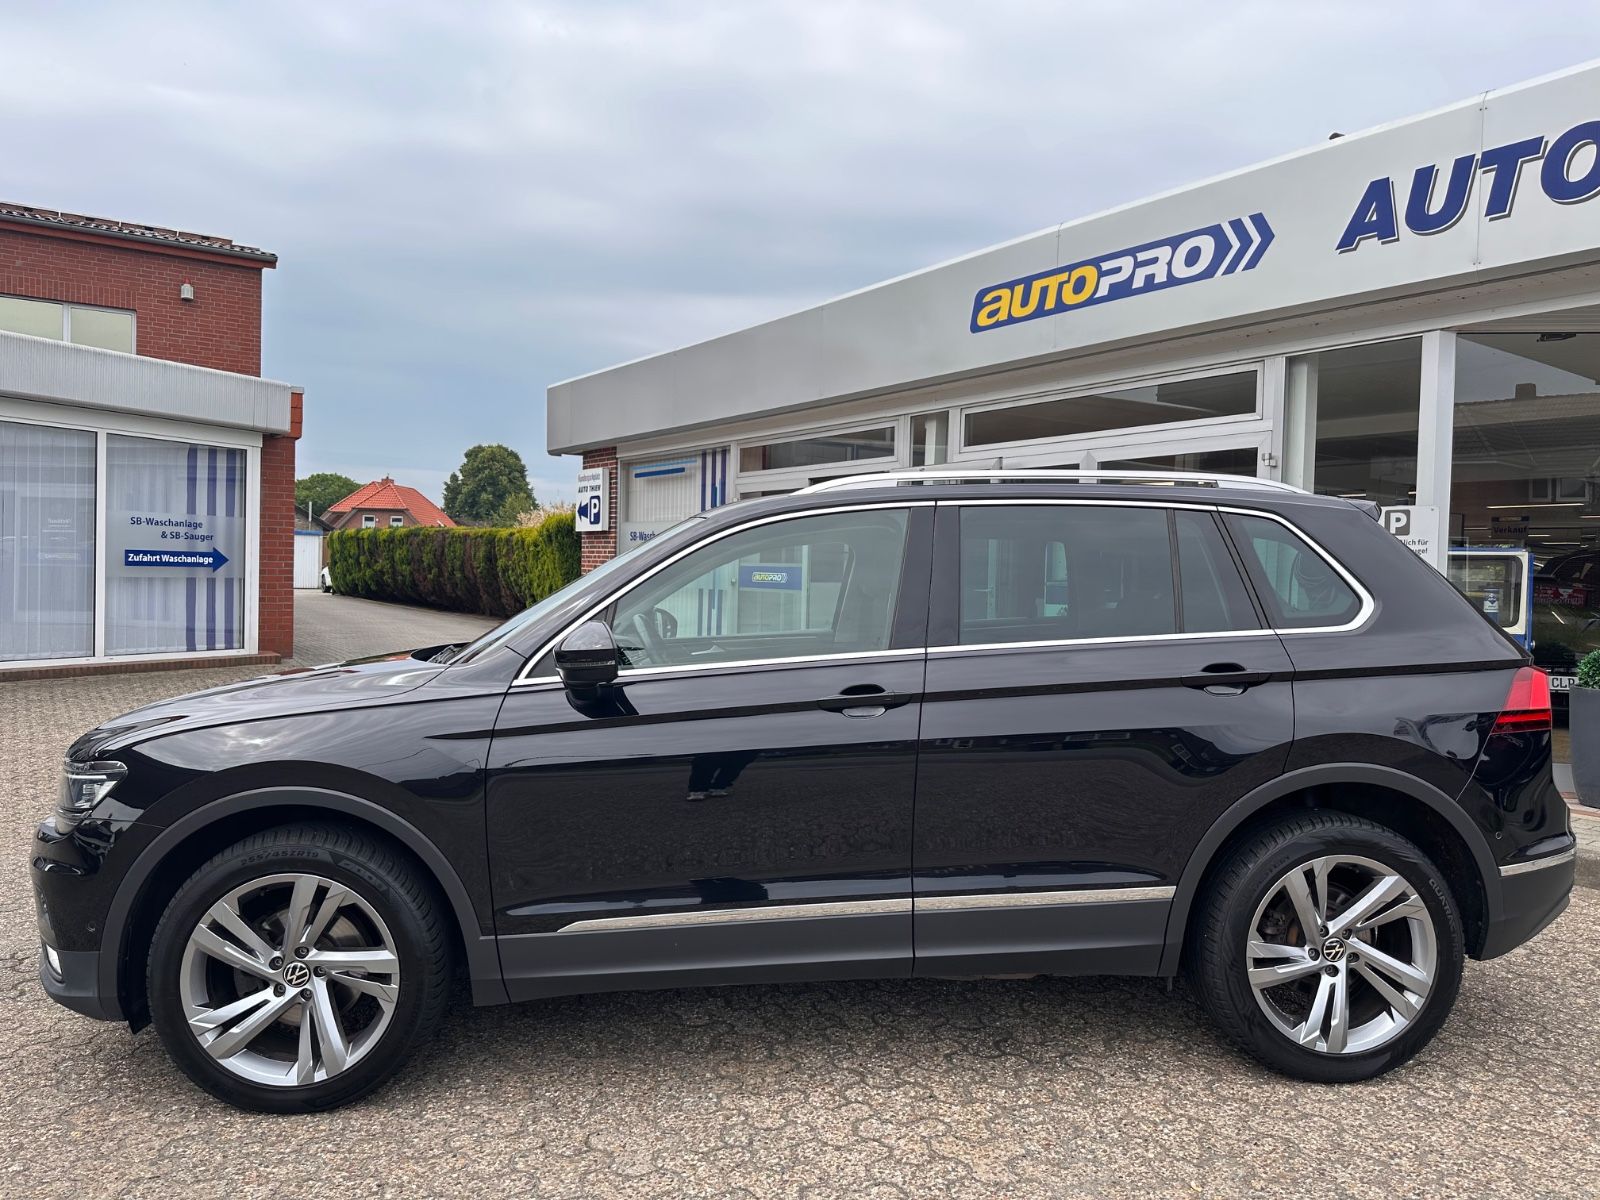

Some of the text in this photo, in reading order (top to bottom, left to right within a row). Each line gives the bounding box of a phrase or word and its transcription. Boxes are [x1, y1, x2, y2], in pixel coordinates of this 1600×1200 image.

[1335, 120, 1600, 254] AUTO
[578, 485, 588, 493] AUTO
[130, 516, 204, 530] SB-Waschanlage
[1390, 512, 1407, 534] P
[160, 530, 214, 542] & SB-Sauger
[128, 553, 214, 565] Zufahrt Waschanlage
